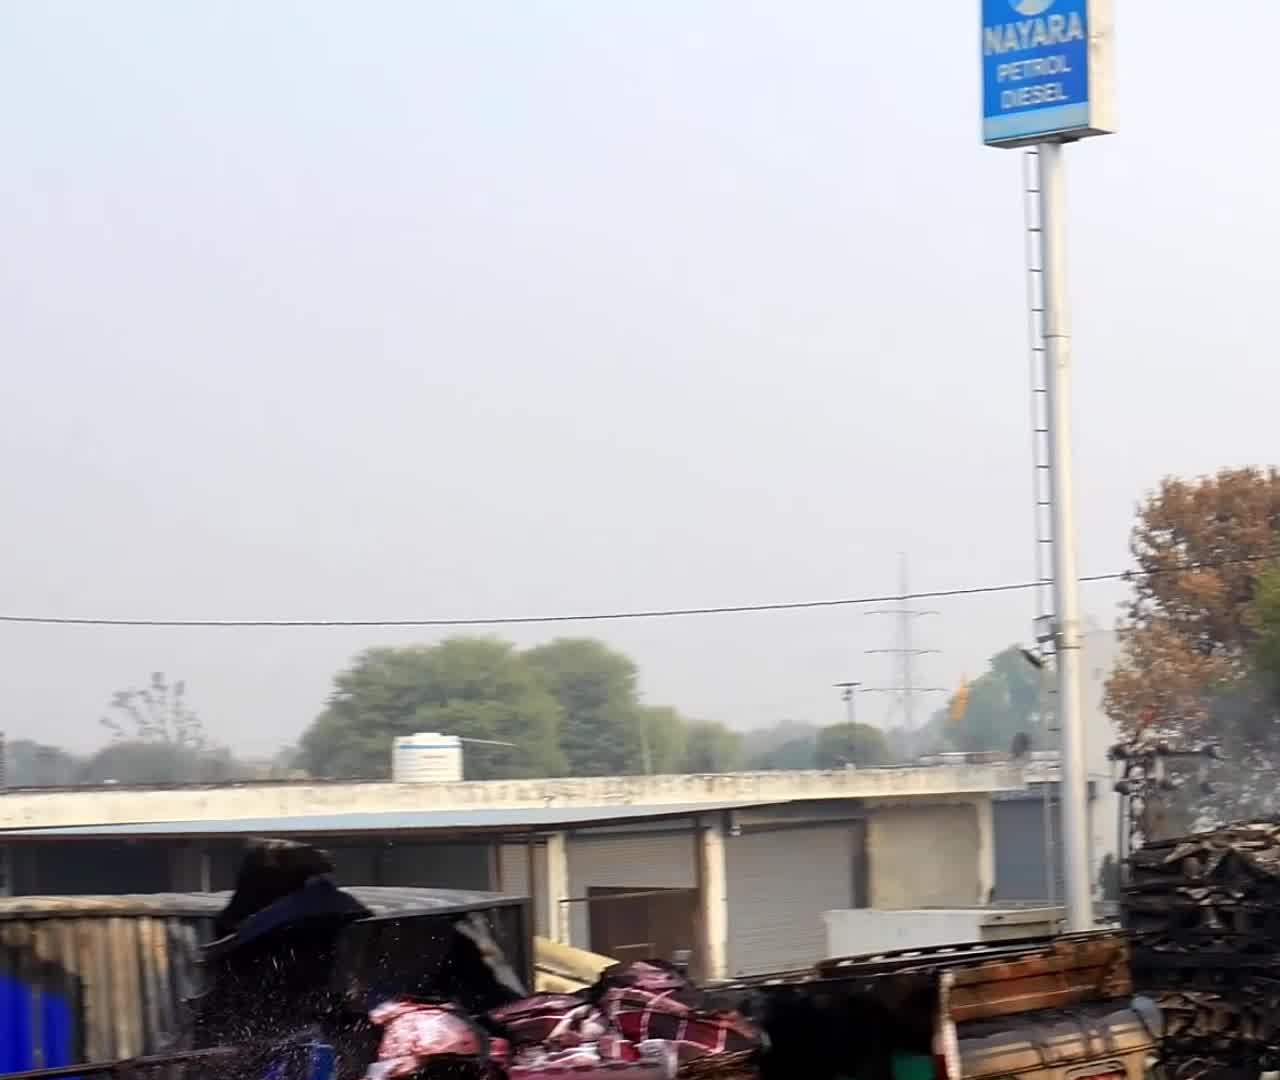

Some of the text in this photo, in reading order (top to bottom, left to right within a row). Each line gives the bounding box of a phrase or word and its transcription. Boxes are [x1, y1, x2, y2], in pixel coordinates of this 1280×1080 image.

[983, 12, 1084, 56] NAYARA
[997, 55, 1072, 83] PETROL
[1001, 82, 1068, 109] DIESEL
